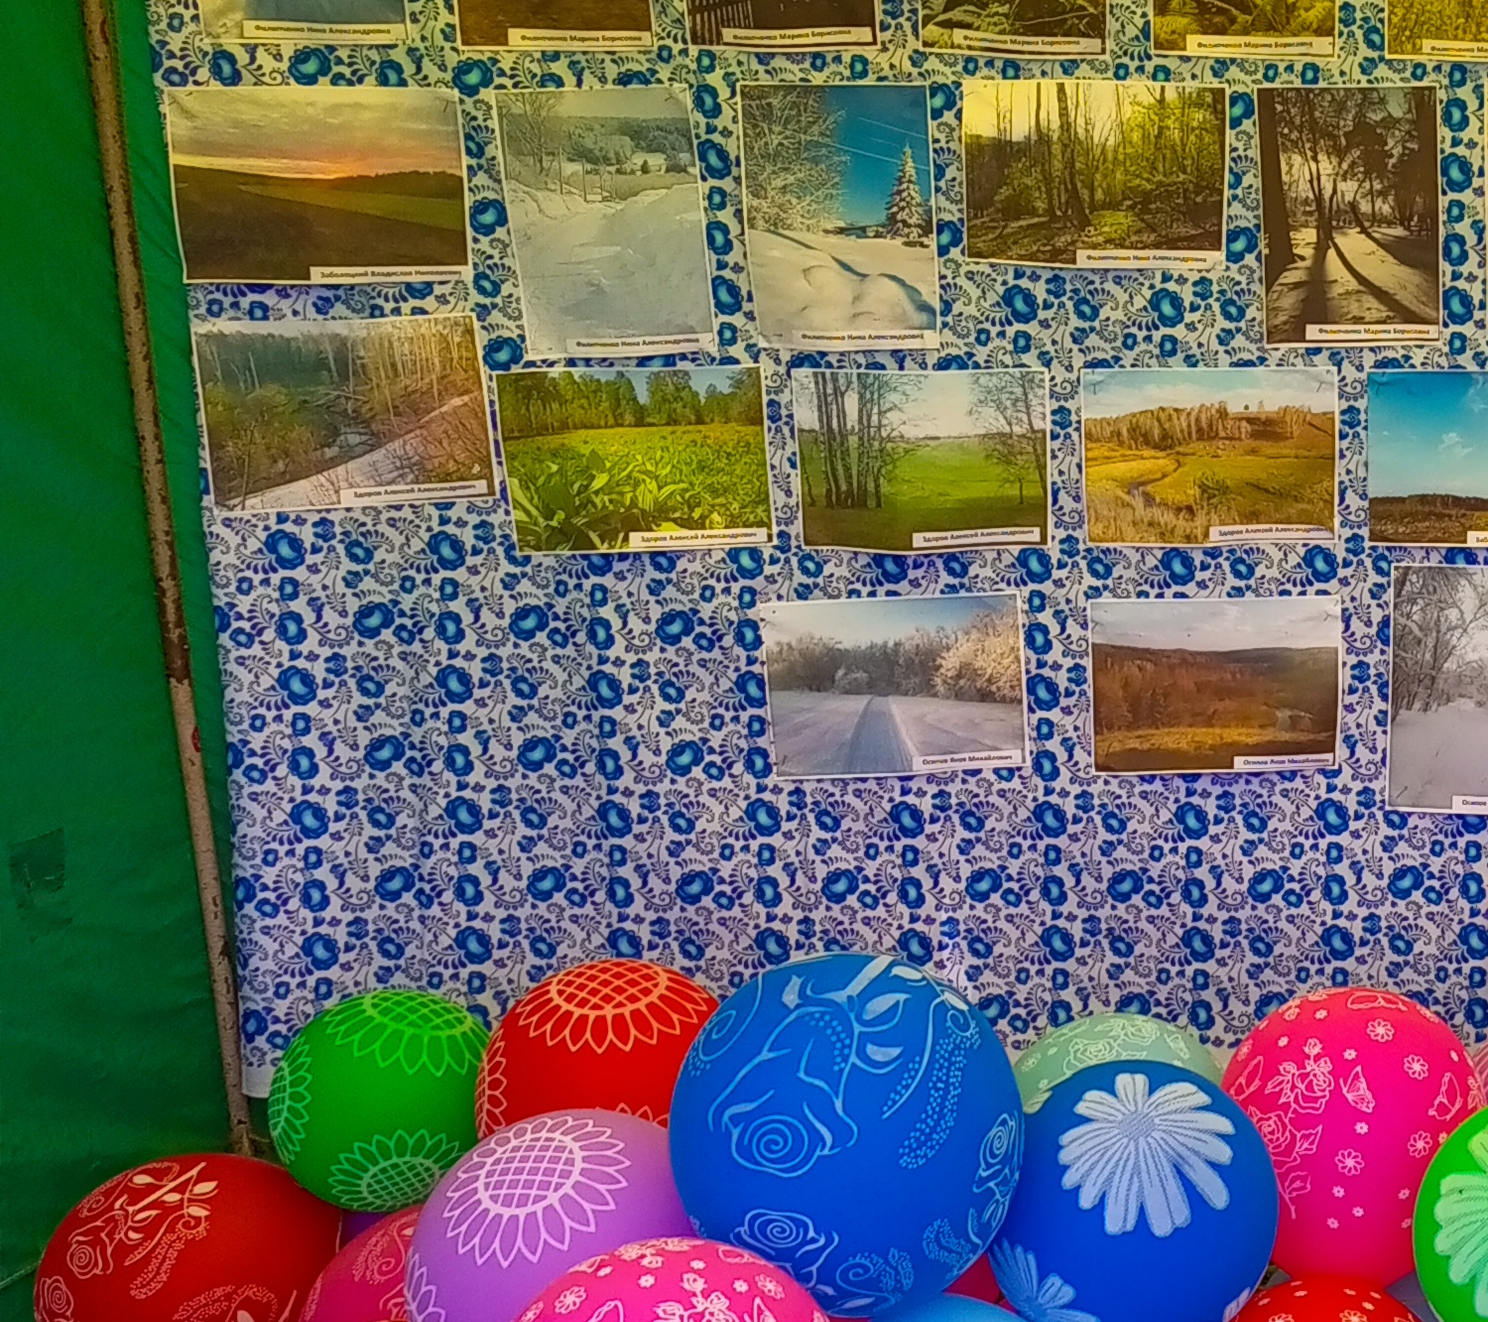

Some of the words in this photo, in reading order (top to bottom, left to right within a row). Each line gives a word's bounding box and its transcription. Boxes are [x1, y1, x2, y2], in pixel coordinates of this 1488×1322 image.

[328, 27, 391, 35] Александровна
[779, 32, 810, 40] Марина
[811, 29, 851, 38] Борисовна
[569, 35, 600, 43] Марина
[602, 34, 642, 43] Борисовна
[1010, 38, 1039, 46] Марина
[1244, 41, 1273, 49] Марина
[1275, 40, 1313, 48] Борисовна
[1152, 255, 1206, 263] Александровна
[371, 270, 413, 278] Владислав
[415, 269, 462, 277] Николаевич
[1363, 327, 1391, 336] Марина
[1393, 327, 1430, 336] Борисовна
[642, 337, 699, 346] Александровна
[384, 487, 415, 495] Алексей
[417, 484, 476, 494] Александрович
[950, 531, 978, 540] Алексей
[980, 529, 1034, 538] Александрович
[1275, 526, 1328, 534] Александрович
[700, 531, 757, 541] Александрович
[968, 754, 1012, 763] Михайлович
